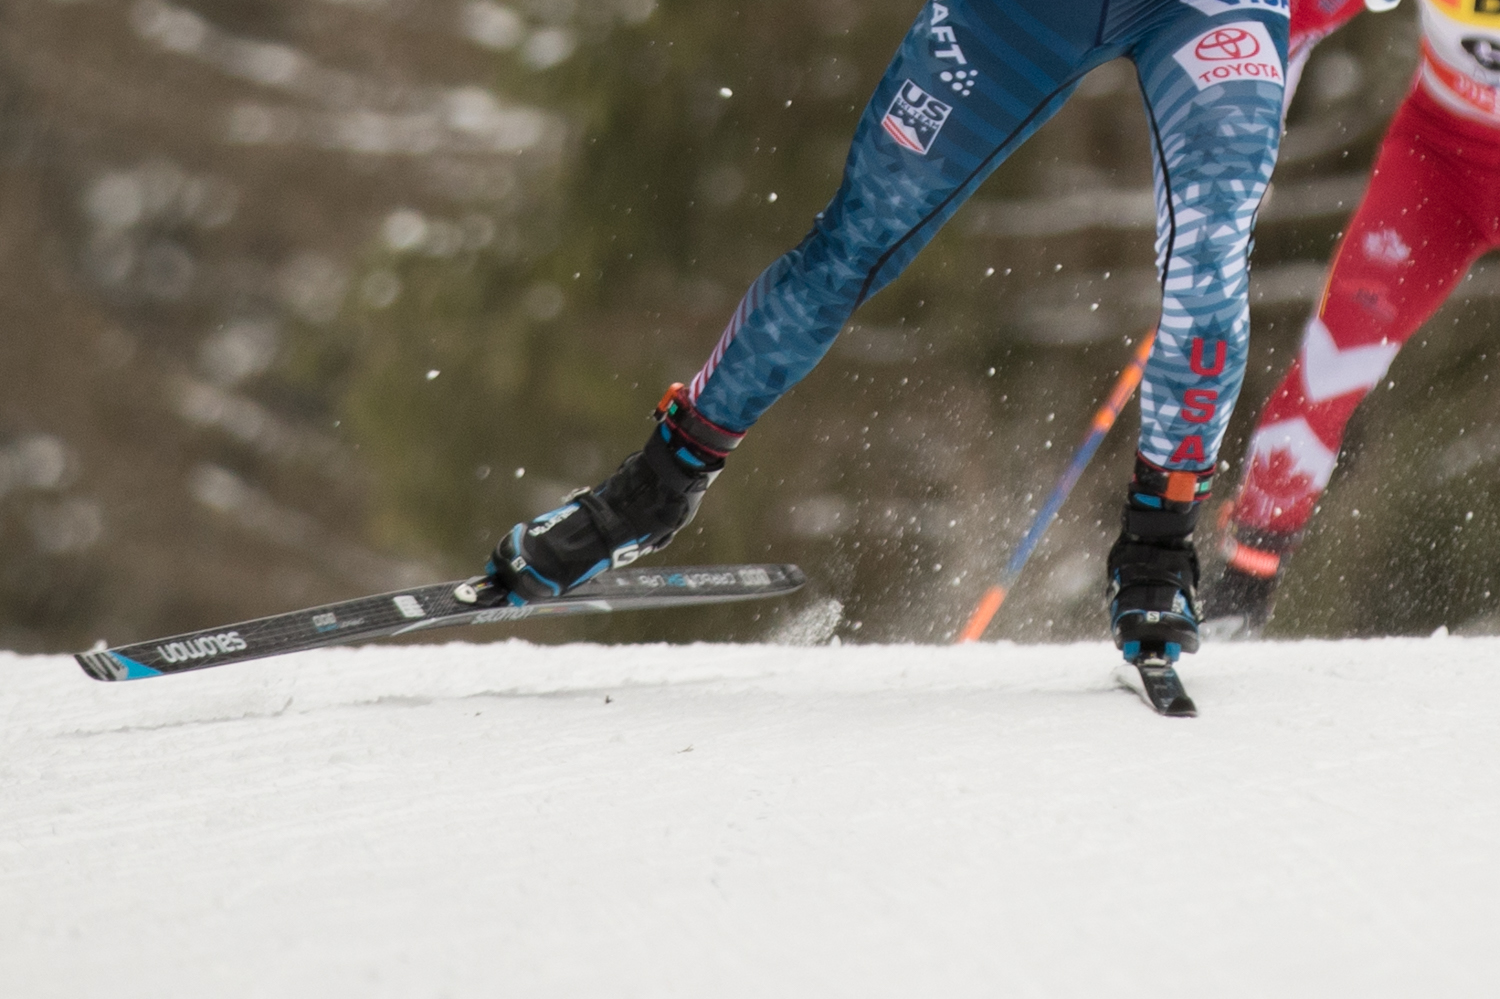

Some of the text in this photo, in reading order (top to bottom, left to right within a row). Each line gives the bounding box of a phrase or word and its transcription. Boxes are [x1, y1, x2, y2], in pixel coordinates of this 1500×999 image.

[1199, 62, 1281, 83] TOYOTA
[901, 83, 949, 122] US
[1170, 337, 1227, 463] USA
